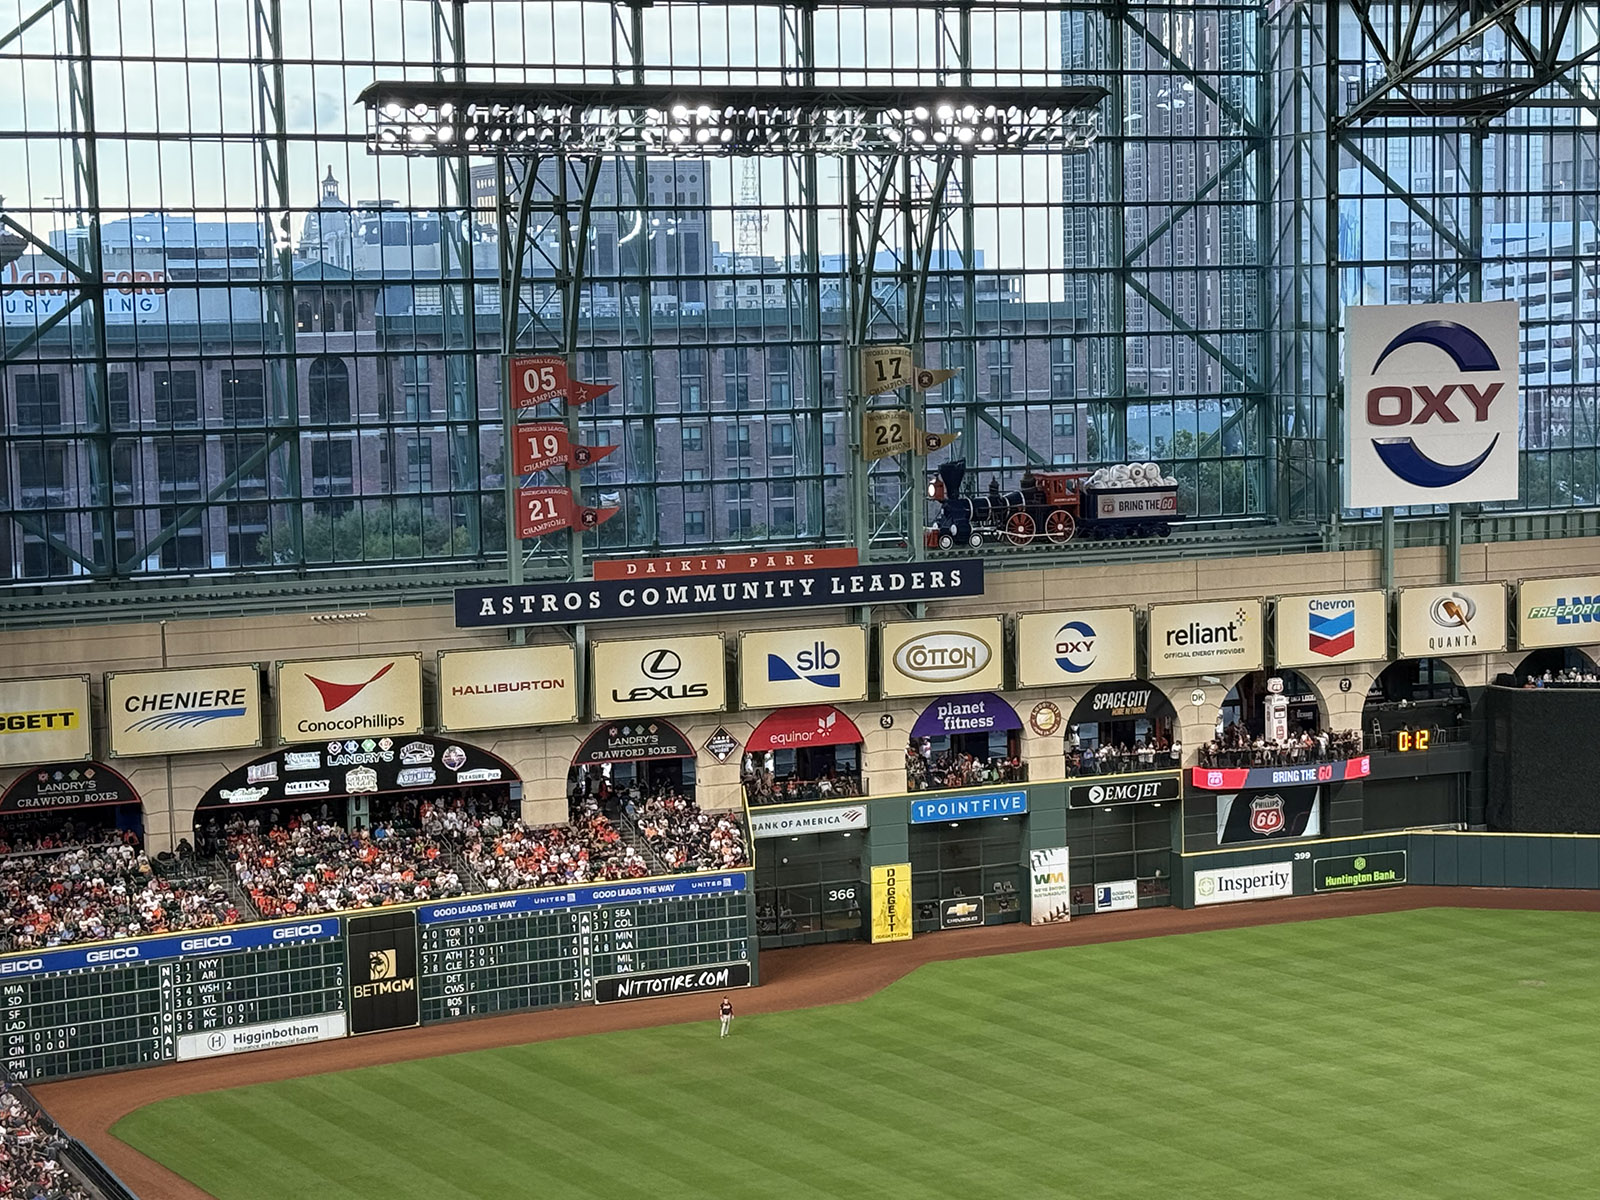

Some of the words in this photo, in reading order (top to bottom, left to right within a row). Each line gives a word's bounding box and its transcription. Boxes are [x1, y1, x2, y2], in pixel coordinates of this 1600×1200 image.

[21, 272, 170, 296] CRAFORD
[6, 299, 51, 314] URY
[874, 357, 902, 381] 17
[523, 367, 556, 394] 05
[520, 388, 568, 407] CHAMPIONS
[1366, 382, 1505, 426] OXY
[875, 424, 902, 446] 22
[528, 435, 558, 460] 19
[524, 454, 569, 472] CHAMPIONS
[528, 498, 558, 522] 21
[1119, 500, 1144, 511] BRING
[1145, 500, 1160, 510] THE
[1162, 499, 1174, 510] GO
[523, 518, 566, 535] CHAMPIONS
[627, 559, 728, 575] DAIKIN
[750, 554, 816, 568] PARK
[479, 590, 602, 617] ASTROS
[619, 578, 816, 608] COMMUNITY
[832, 570, 962, 595] LEADERS
[1308, 600, 1354, 611] Chevron
[1530, 603, 1598, 618] FREEPORT
[1166, 622, 1238, 646] reliant
[1056, 640, 1095, 654] OXY
[1428, 635, 1478, 650] QUANTA
[796, 641, 840, 670] slb
[906, 644, 976, 672] COTTON
[452, 678, 565, 696] HALLIBURTON
[612, 682, 708, 702] LEXUS
[124, 688, 246, 713] CHENIERE
[1093, 690, 1128, 710] SPACE
[1127, 690, 1151, 708] CITY
[1191, 693, 1204, 702] DK
[937, 701, 985, 720] planet
[298, 714, 404, 733] ConocoPhillips
[882, 717, 891, 725] 24
[944, 715, 994, 730] fitness
[608, 735, 658, 746] LANDRY'S
[770, 730, 814, 744] equinor
[1398, 730, 1428, 751] 0:12
[327, 751, 394, 766] LANDRY'S
[591, 748, 644, 760] CRAWFORD
[648, 746, 677, 755] BOXES
[1272, 770, 1300, 782] BRING
[1301, 769, 1316, 780] THE
[1318, 766, 1332, 780] GO
[38, 780, 96, 792] LANDRY'S
[1104, 782, 1162, 800] EMCJET
[17, 794, 80, 808] CRAWFORD
[84, 792, 118, 803] BOXES
[918, 796, 1020, 818] 1POINTFIVE
[1255, 800, 1280, 808] PHILLIPS
[752, 822, 778, 830] BANK
[781, 820, 794, 828] OF
[796, 816, 840, 827] AMERICA
[1256, 811, 1278, 826] 66
[1294, 852, 1310, 860] 399
[1034, 872, 1064, 884] WM
[1218, 871, 1290, 893] Insperity
[1326, 874, 1372, 886] Huntington
[1374, 870, 1396, 881] Bank
[592, 890, 616, 900] GOOD
[618, 886, 642, 898] LEADS
[643, 885, 656, 894] THE
[658, 884, 676, 893] WAY
[692, 880, 722, 888] UNITED
[829, 888, 856, 901] 366
[434, 907, 458, 918] GOOD
[458, 904, 482, 914] LEADS
[484, 902, 498, 912] THE
[499, 900, 517, 910] WAY
[534, 896, 566, 904] UNITED
[886, 868, 896, 932] DOGGETT
[614, 909, 632, 918] SEA
[614, 919, 632, 928] COL
[273, 924, 322, 939] GEICO
[444, 928, 460, 937] TOR
[616, 931, 632, 940] MIN
[181, 936, 232, 950] GEICO
[446, 938, 460, 947] TEX
[616, 942, 633, 950] LAA
[86, 947, 139, 962] GEICO
[445, 951, 462, 960] ATH
[470, 949, 474, 958] 2
[480, 948, 485, 956] 0
[490, 946, 494, 954] 1
[500, 945, 504, 953] 1
[581, 914, 592, 998] AMERICAN
[617, 954, 632, 962] MIL
[0, 959, 42, 974] EICO
[198, 959, 220, 970] NYY
[446, 961, 462, 971] CLE
[617, 964, 634, 973] BAL
[202, 970, 216, 980] ARI
[446, 974, 461, 984] DET
[618, 968, 728, 997] NITTOTIRE.COM
[4, 985, 24, 995] MIA
[198, 982, 220, 994] WSH
[354, 978, 414, 998] BETMGM
[444, 984, 464, 994] CWS
[470, 982, 475, 990] F
[8, 996, 22, 1006] SD
[202, 994, 216, 1004] STL
[448, 997, 462, 1006] BOS
[8, 1010, 21, 1020] SF
[162, 966, 172, 1057] NATIONAL
[203, 1008, 216, 1018] KC
[450, 1007, 460, 1016] TB
[471, 1006, 476, 1014] F
[6, 1021, 26, 1032] LAD
[204, 1018, 216, 1028] PIT
[9, 1036, 24, 1044] CHI
[35, 1032, 40, 1041] 0
[47, 1030, 51, 1039] 1
[58, 1029, 64, 1038] 0
[70, 1027, 76, 1036] 0
[234, 1024, 318, 1044] Higginbotham
[9, 1046, 24, 1056] CIN
[35, 1044, 41, 1052] 0
[47, 1042, 53, 1050] 0
[58, 1040, 65, 1048] 0
[9, 1060, 26, 1070] PHI
[36, 1068, 42, 1077] F
